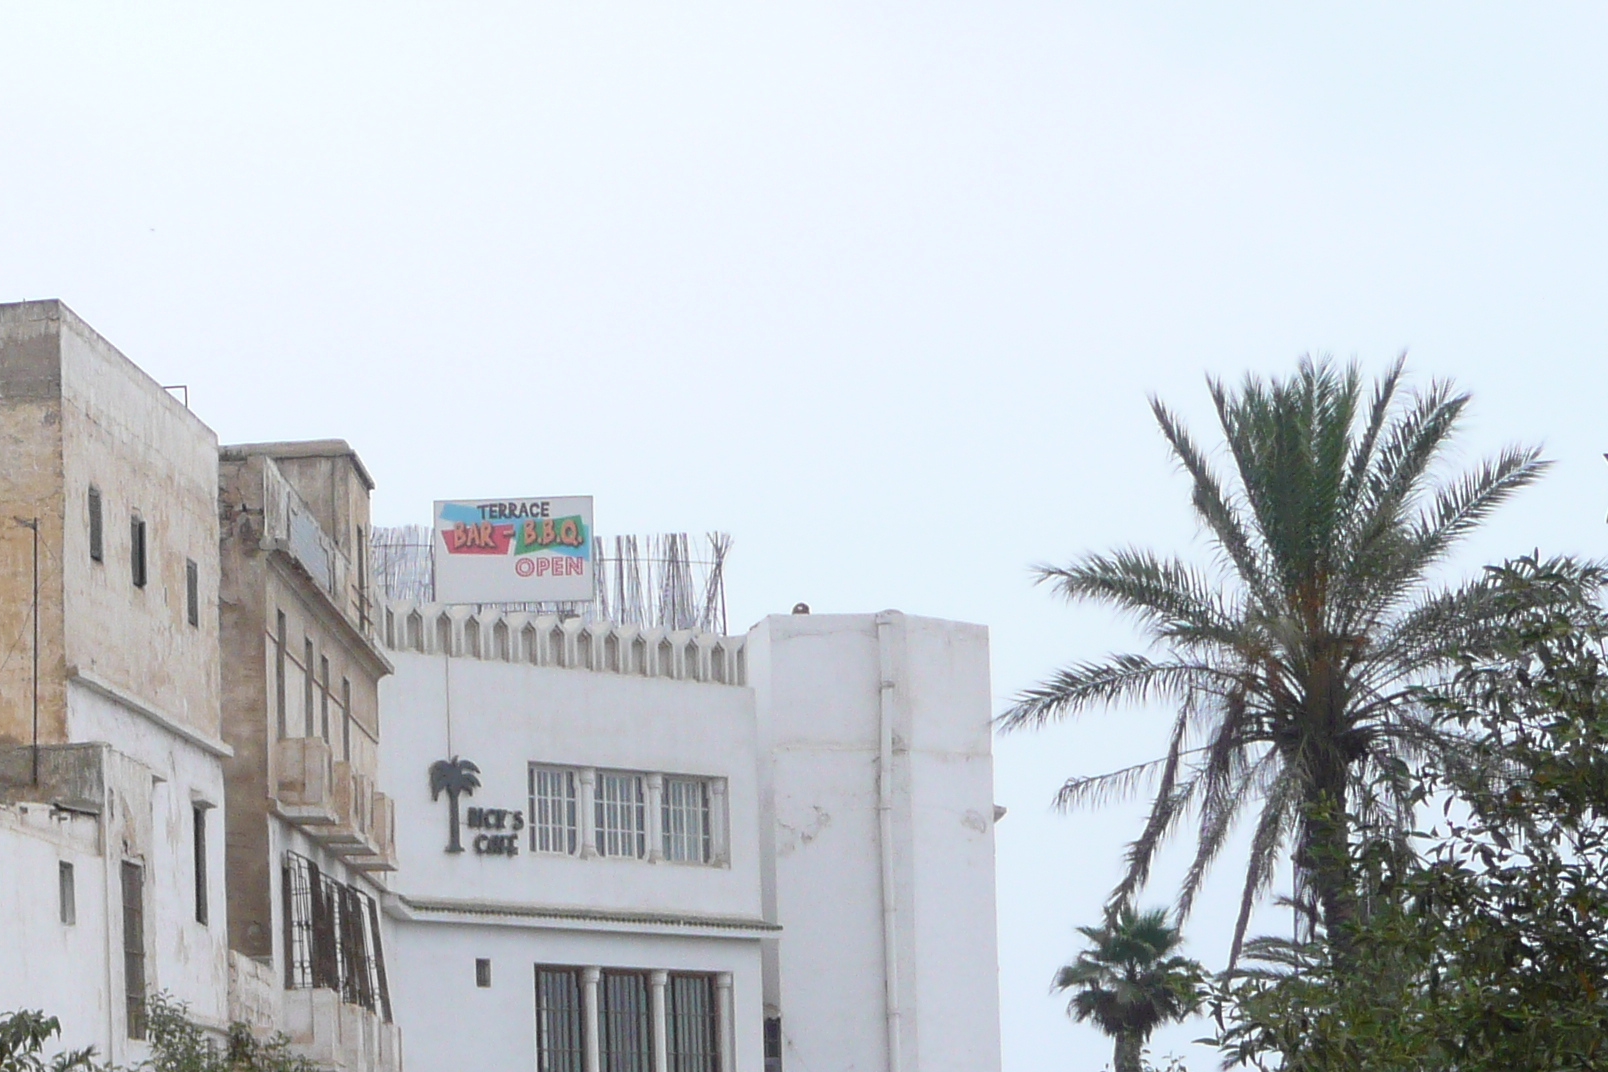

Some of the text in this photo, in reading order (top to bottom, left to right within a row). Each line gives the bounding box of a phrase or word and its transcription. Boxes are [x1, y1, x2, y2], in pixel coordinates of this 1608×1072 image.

[477, 502, 550, 519] TERRACE
[454, 521, 496, 549] BAR
[523, 519, 583, 547] B.B.Q.
[515, 556, 583, 577] OPEN
